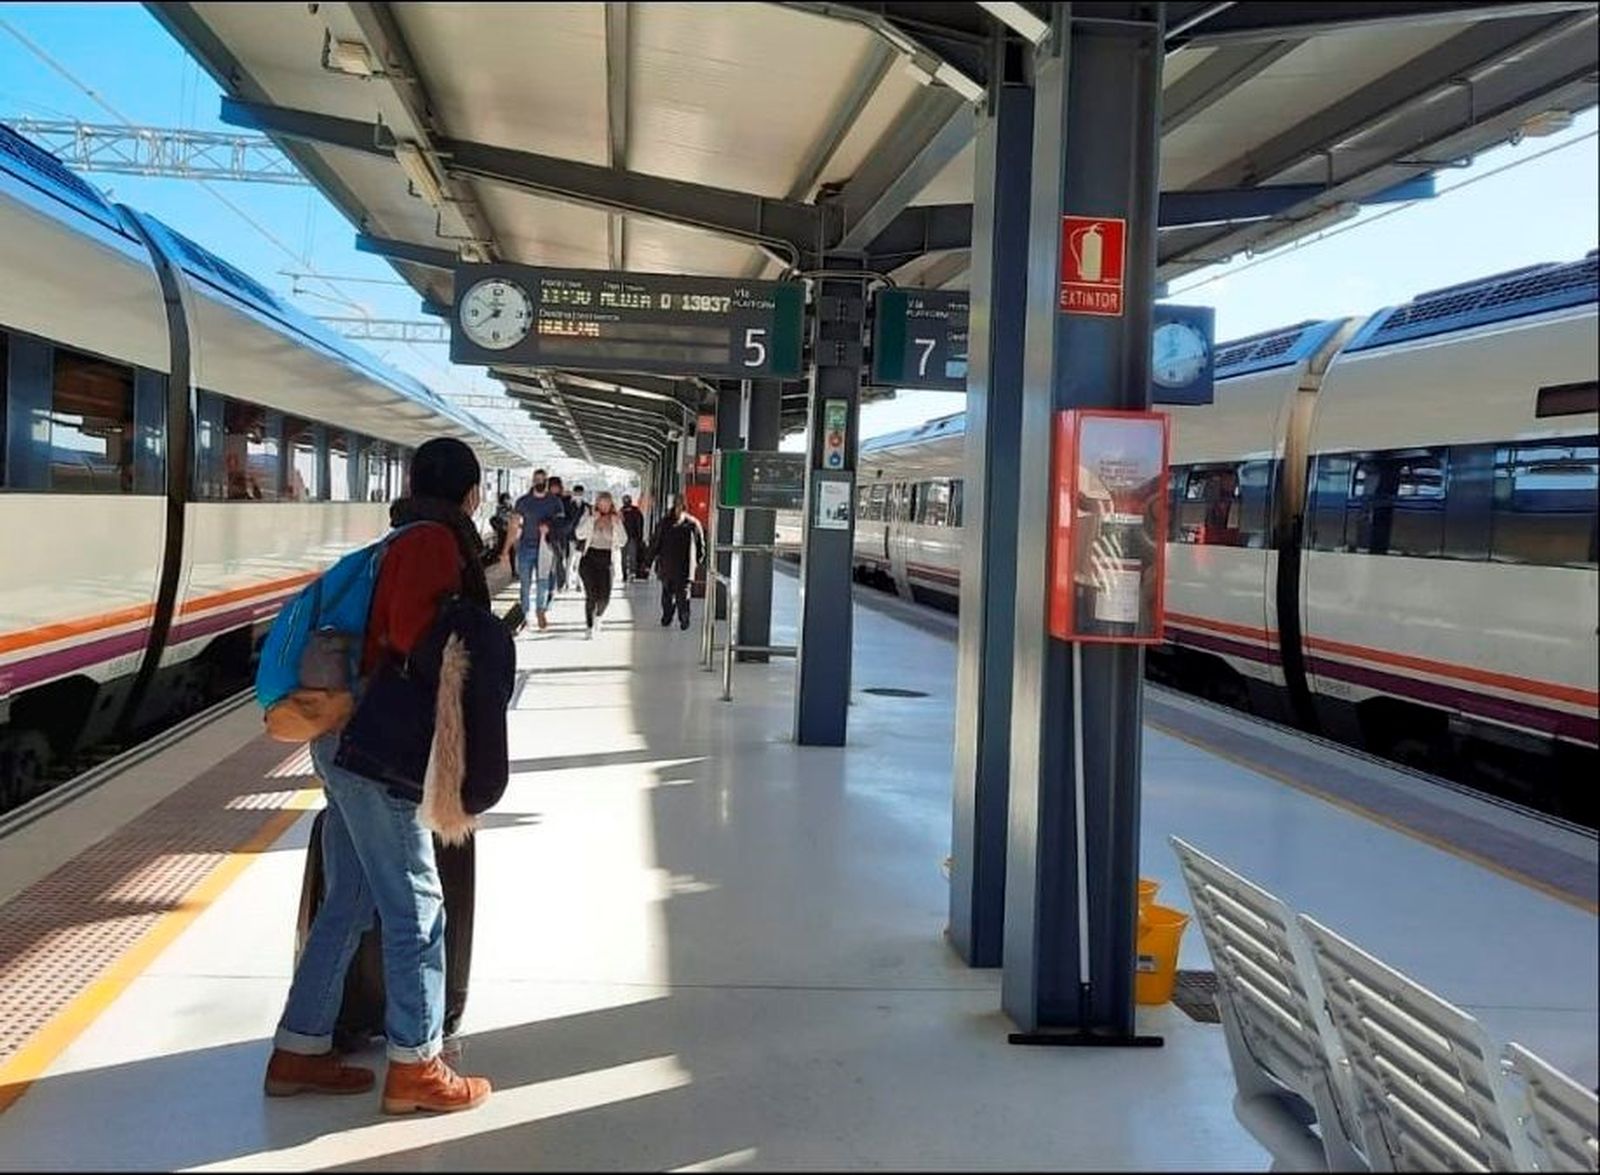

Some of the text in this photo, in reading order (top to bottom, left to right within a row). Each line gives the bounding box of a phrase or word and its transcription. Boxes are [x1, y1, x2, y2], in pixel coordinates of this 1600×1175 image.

[1060, 290, 1118, 309] EXTINTOR
[743, 328, 766, 368] 5
[914, 338, 936, 377] 7
